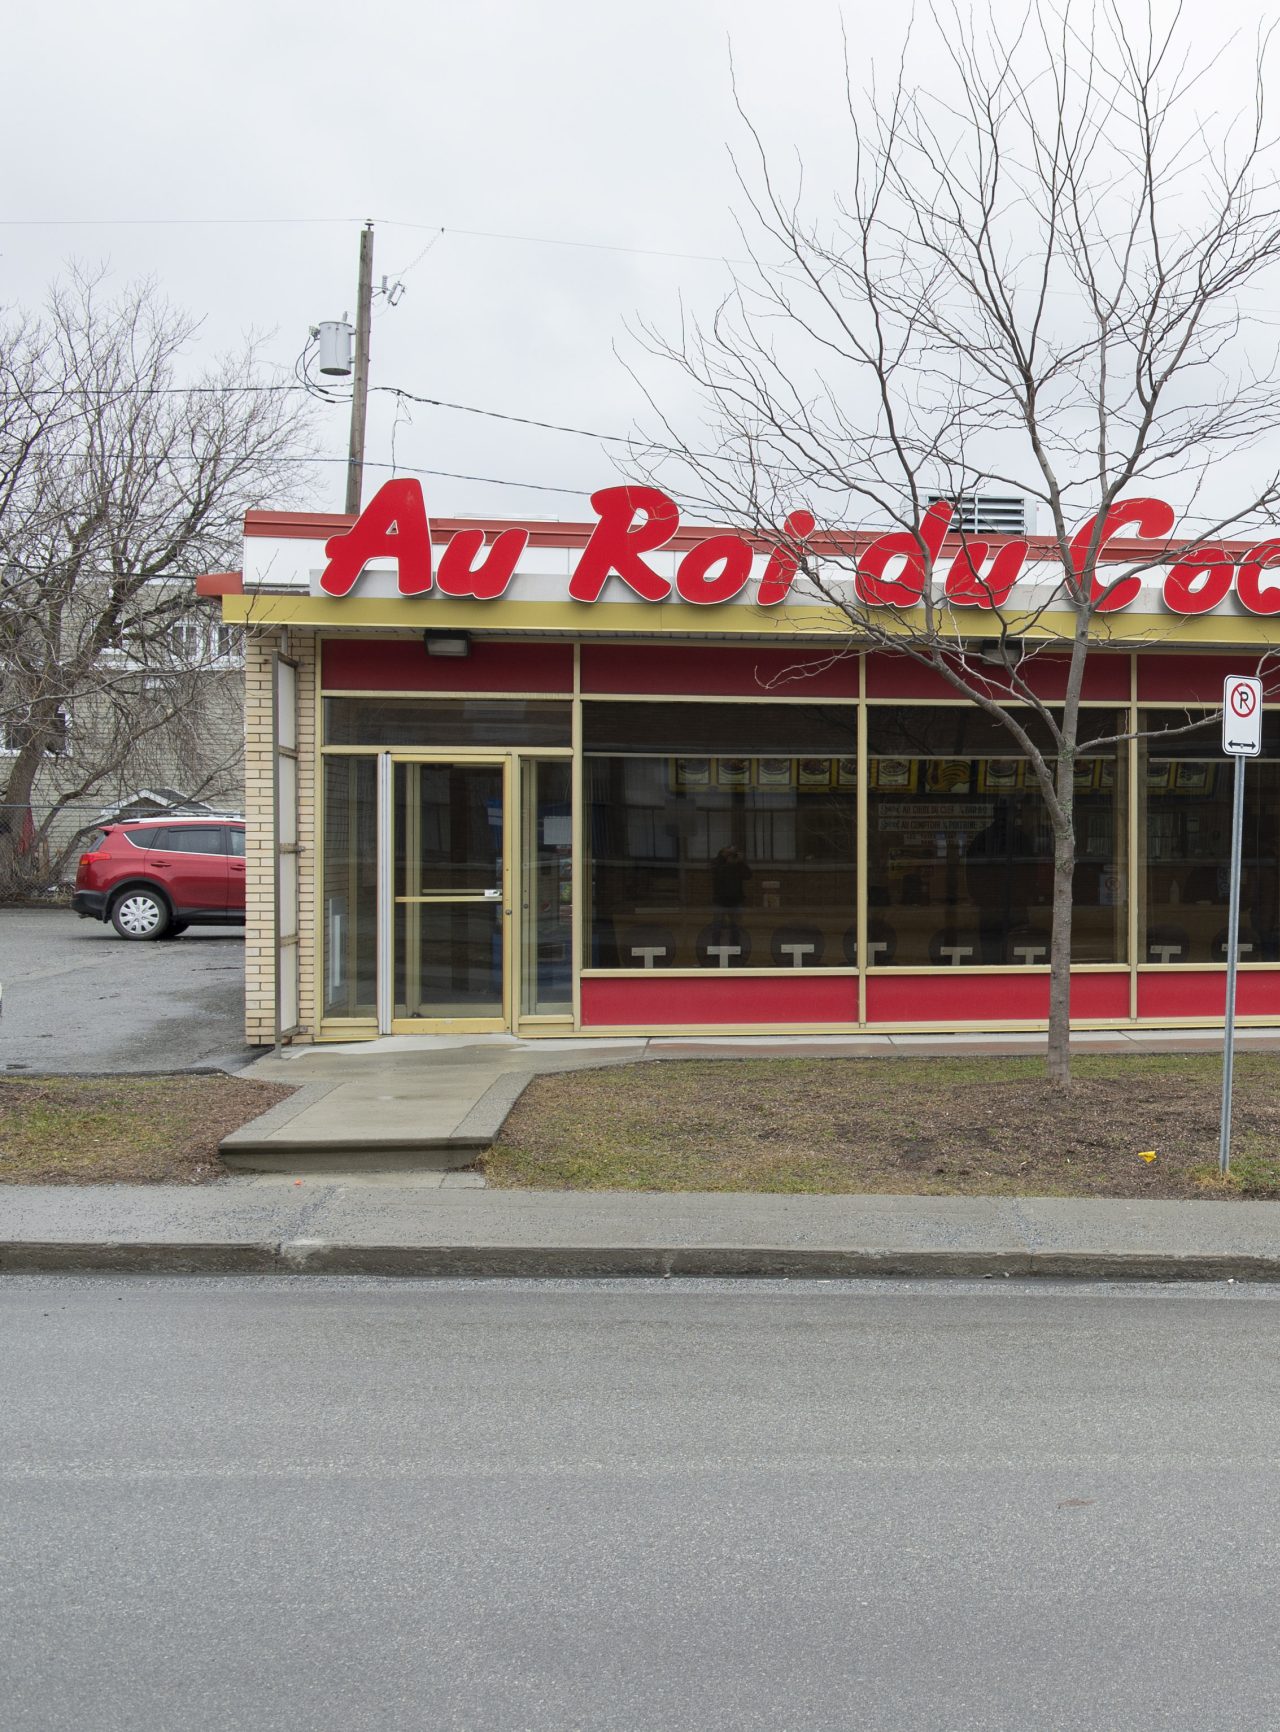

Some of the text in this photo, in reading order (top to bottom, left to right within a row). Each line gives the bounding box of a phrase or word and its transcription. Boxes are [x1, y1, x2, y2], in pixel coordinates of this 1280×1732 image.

[319, 478, 530, 601] Au
[568, 485, 815, 607] Roi
[855, 501, 1031, 609] du
[1239, 691, 1249, 710] P
